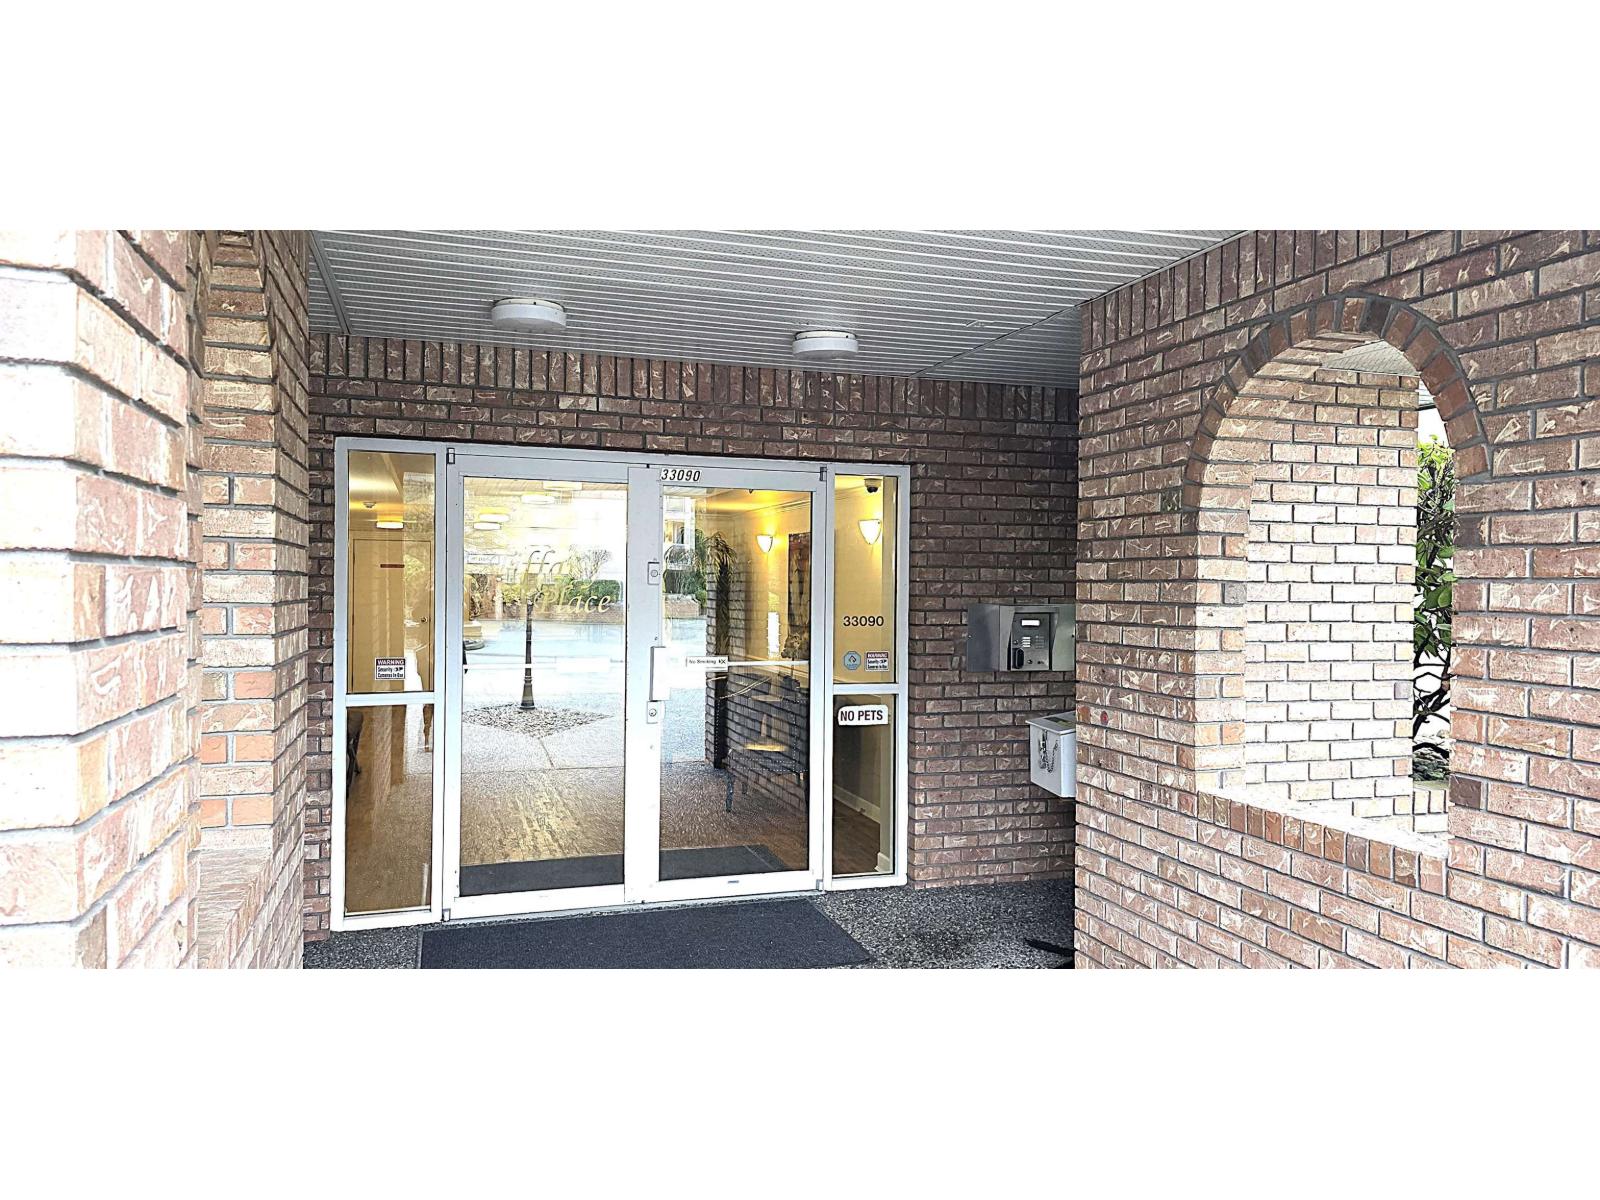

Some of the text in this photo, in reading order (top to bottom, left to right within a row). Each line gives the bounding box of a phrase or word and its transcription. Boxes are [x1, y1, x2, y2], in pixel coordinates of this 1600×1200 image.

[661, 468, 701, 482] 33090
[533, 581, 612, 614] Place
[843, 616, 884, 626] 33090
[840, 709, 883, 721] NO PETS
